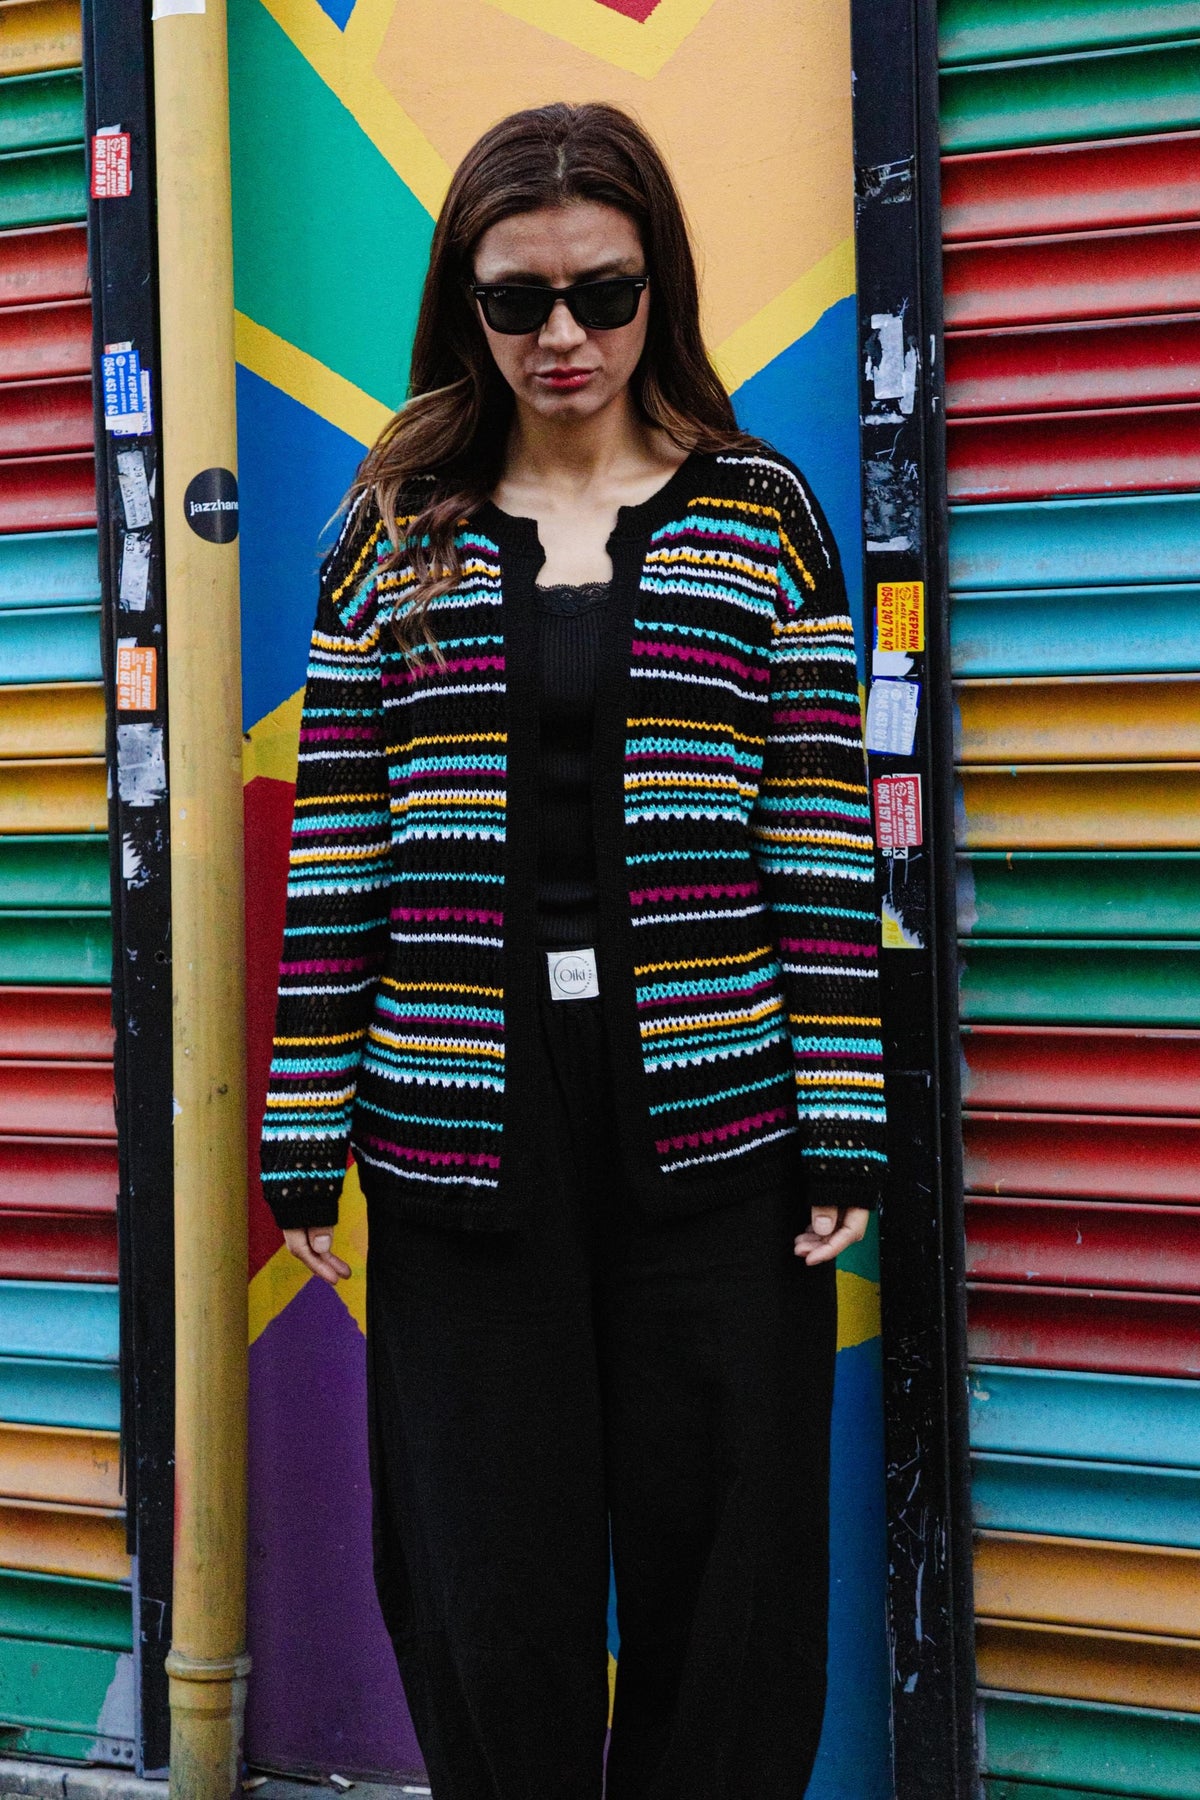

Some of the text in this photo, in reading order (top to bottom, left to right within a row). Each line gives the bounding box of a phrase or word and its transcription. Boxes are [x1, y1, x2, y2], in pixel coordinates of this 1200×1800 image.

[95, 160, 106, 173] 157
[117, 159, 127, 196] KEPENK
[95, 186, 105, 197] 57
[105, 378, 116, 392] 453
[106, 394, 117, 403] 02
[127, 376, 139, 411] KEPENK
[881, 586, 893, 651] 0543 247 79 47
[908, 609, 918, 650] KEPENK
[877, 783, 892, 846] 0542 157 80 57
[904, 781, 917, 846] ÇEVİK KEPENK
[560, 968, 586, 982] Oiki
